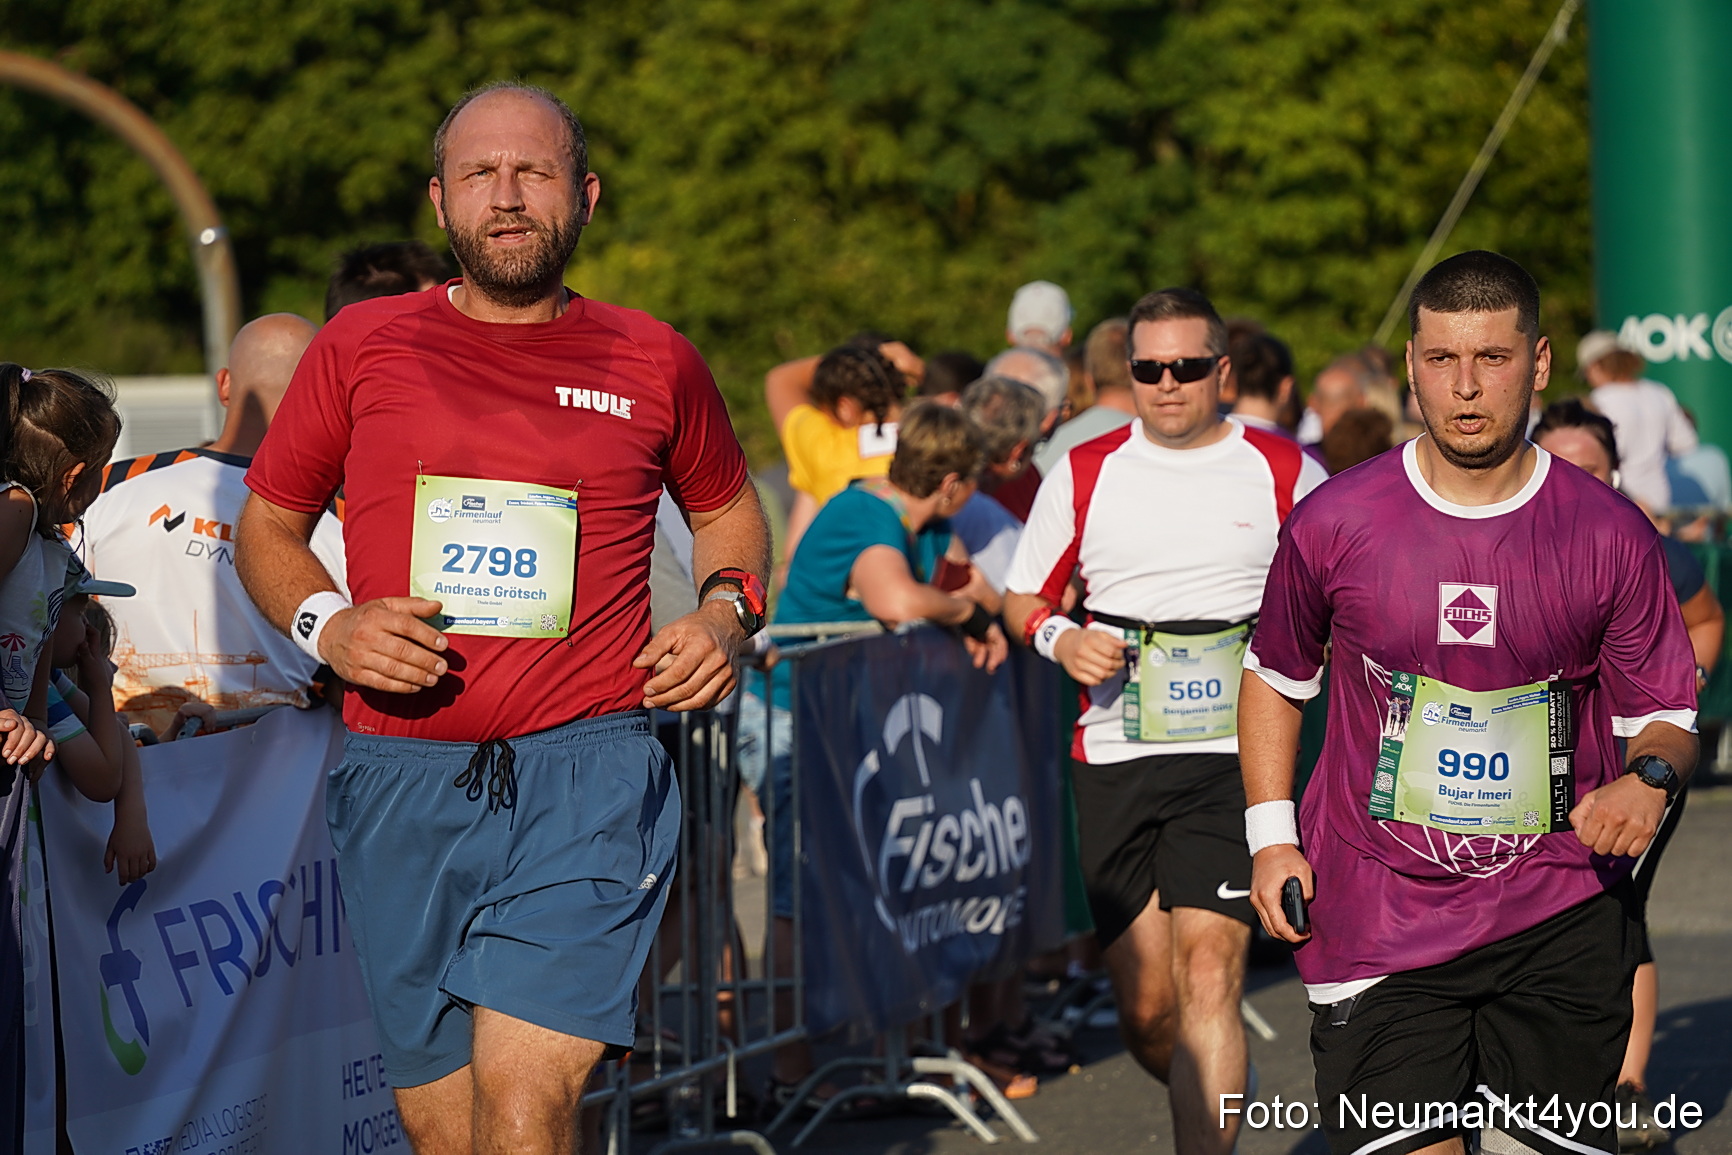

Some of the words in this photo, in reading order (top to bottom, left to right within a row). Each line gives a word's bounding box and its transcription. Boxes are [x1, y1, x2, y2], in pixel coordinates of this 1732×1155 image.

[1617, 313, 1713, 364] AOK
[555, 386, 632, 420] THULE
[454, 510, 502, 519] Firmenlauf
[442, 543, 537, 578] 2798
[434, 581, 490, 597] Andreas
[494, 585, 547, 601] Grötsch
[1443, 608, 1492, 622] FUCHS
[1169, 679, 1221, 700] 560
[1394, 682, 1413, 693] AOK
[1441, 716, 1488, 728] Firmenlauf
[1550, 727, 1556, 735] %
[1550, 735, 1557, 749] 20
[1438, 748, 1510, 781] 990
[1438, 784, 1474, 801] Bujar
[1478, 788, 1512, 800] Imeri
[1554, 778, 1564, 822] HILTL
[342, 1053, 386, 1100] HEUTE
